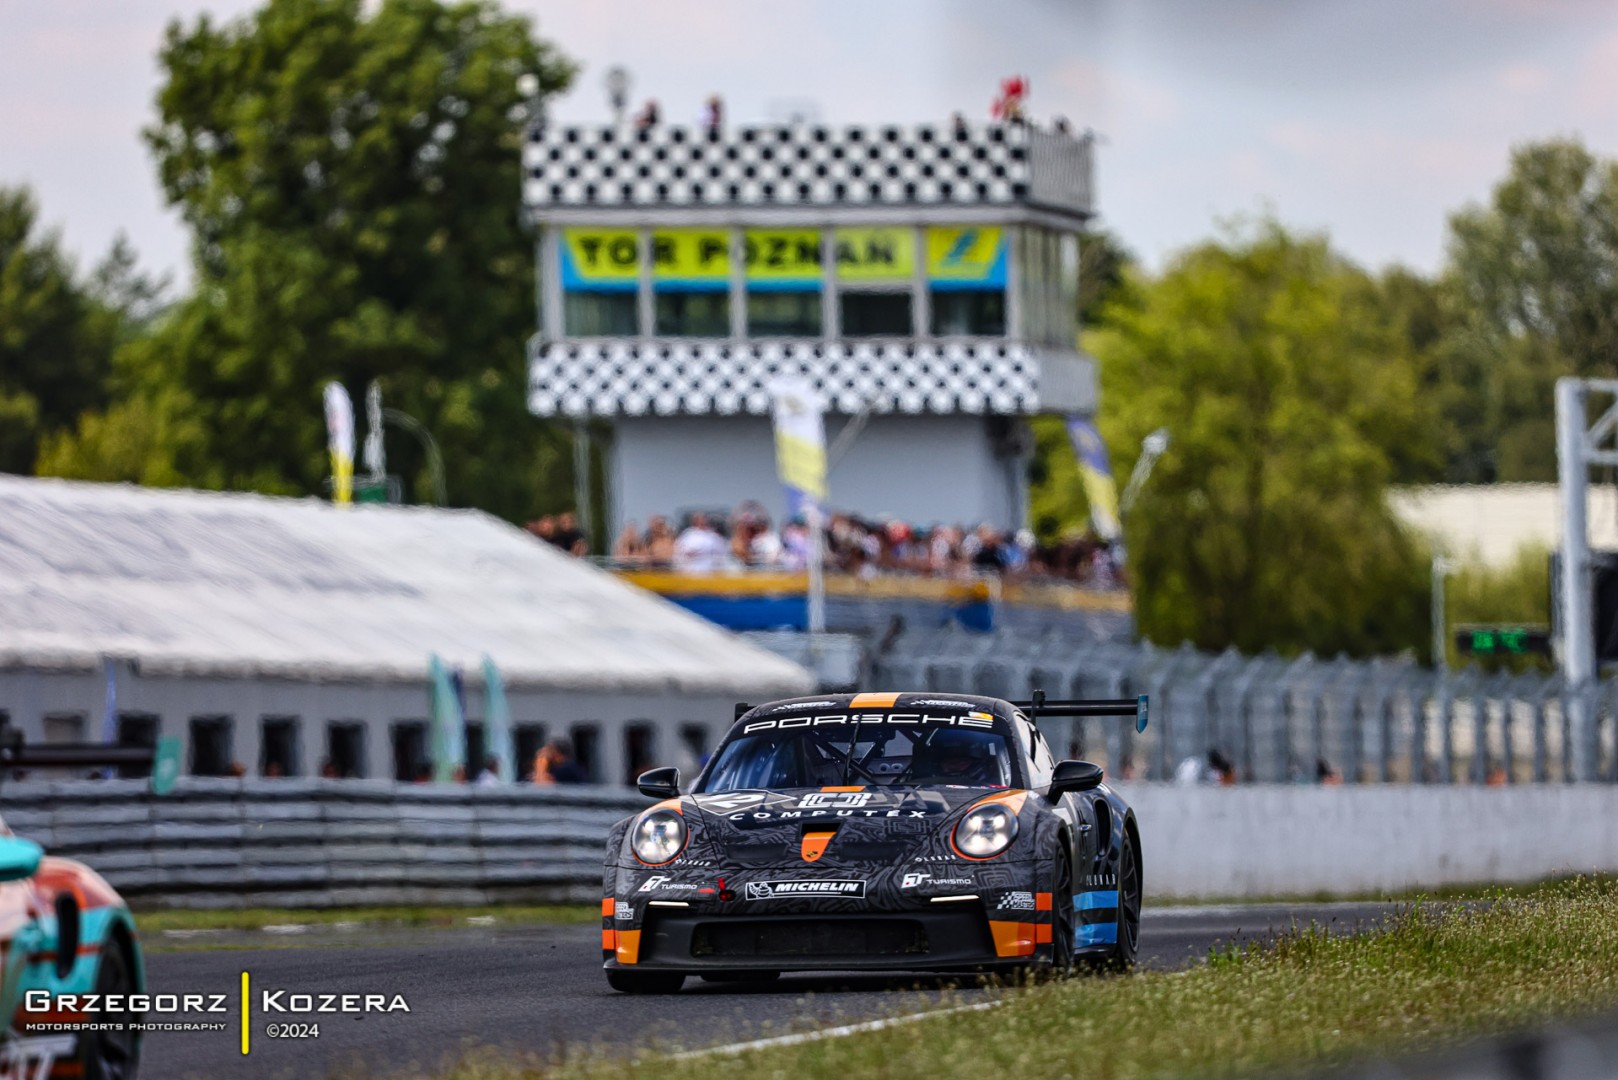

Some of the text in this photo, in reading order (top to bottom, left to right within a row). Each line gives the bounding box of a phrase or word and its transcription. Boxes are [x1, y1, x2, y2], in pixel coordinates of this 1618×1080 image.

[578, 236, 677, 265] TOR
[743, 713, 993, 735] PORSCHE
[728, 809, 928, 821] COMPUTEX
[774, 882, 860, 892] MICHELIN
